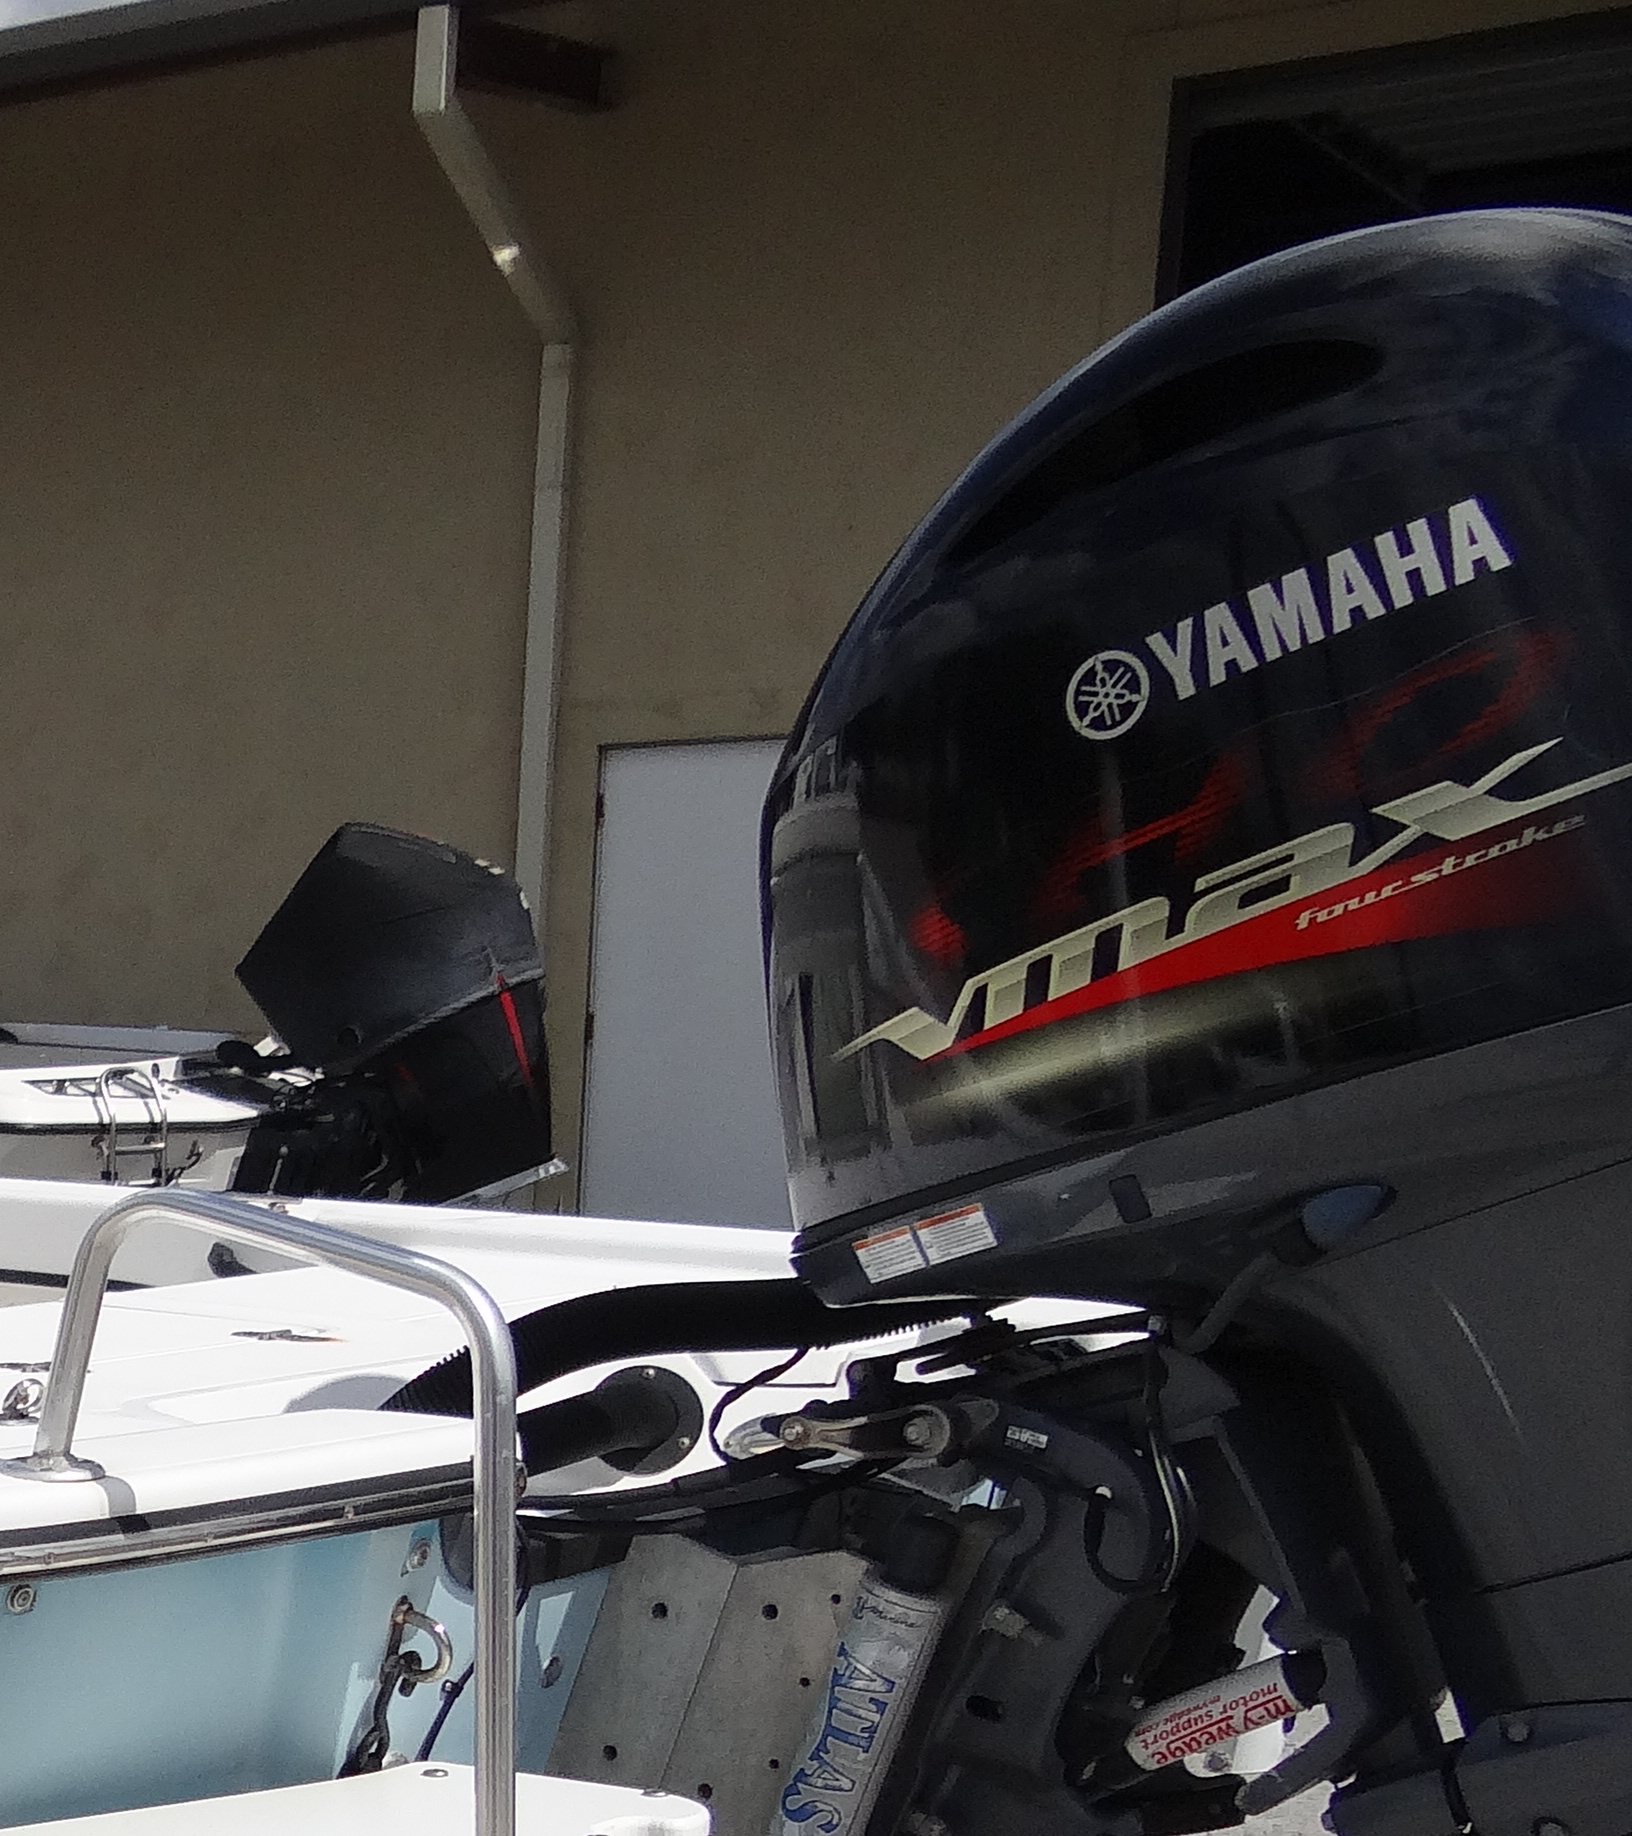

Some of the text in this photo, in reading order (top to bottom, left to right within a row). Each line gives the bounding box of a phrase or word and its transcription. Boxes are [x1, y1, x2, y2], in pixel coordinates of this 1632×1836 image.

[1147, 496, 1514, 701] YAMAHA
[782, 1641, 897, 1834] ATLAS
[1140, 1682, 1279, 1751] motor support
